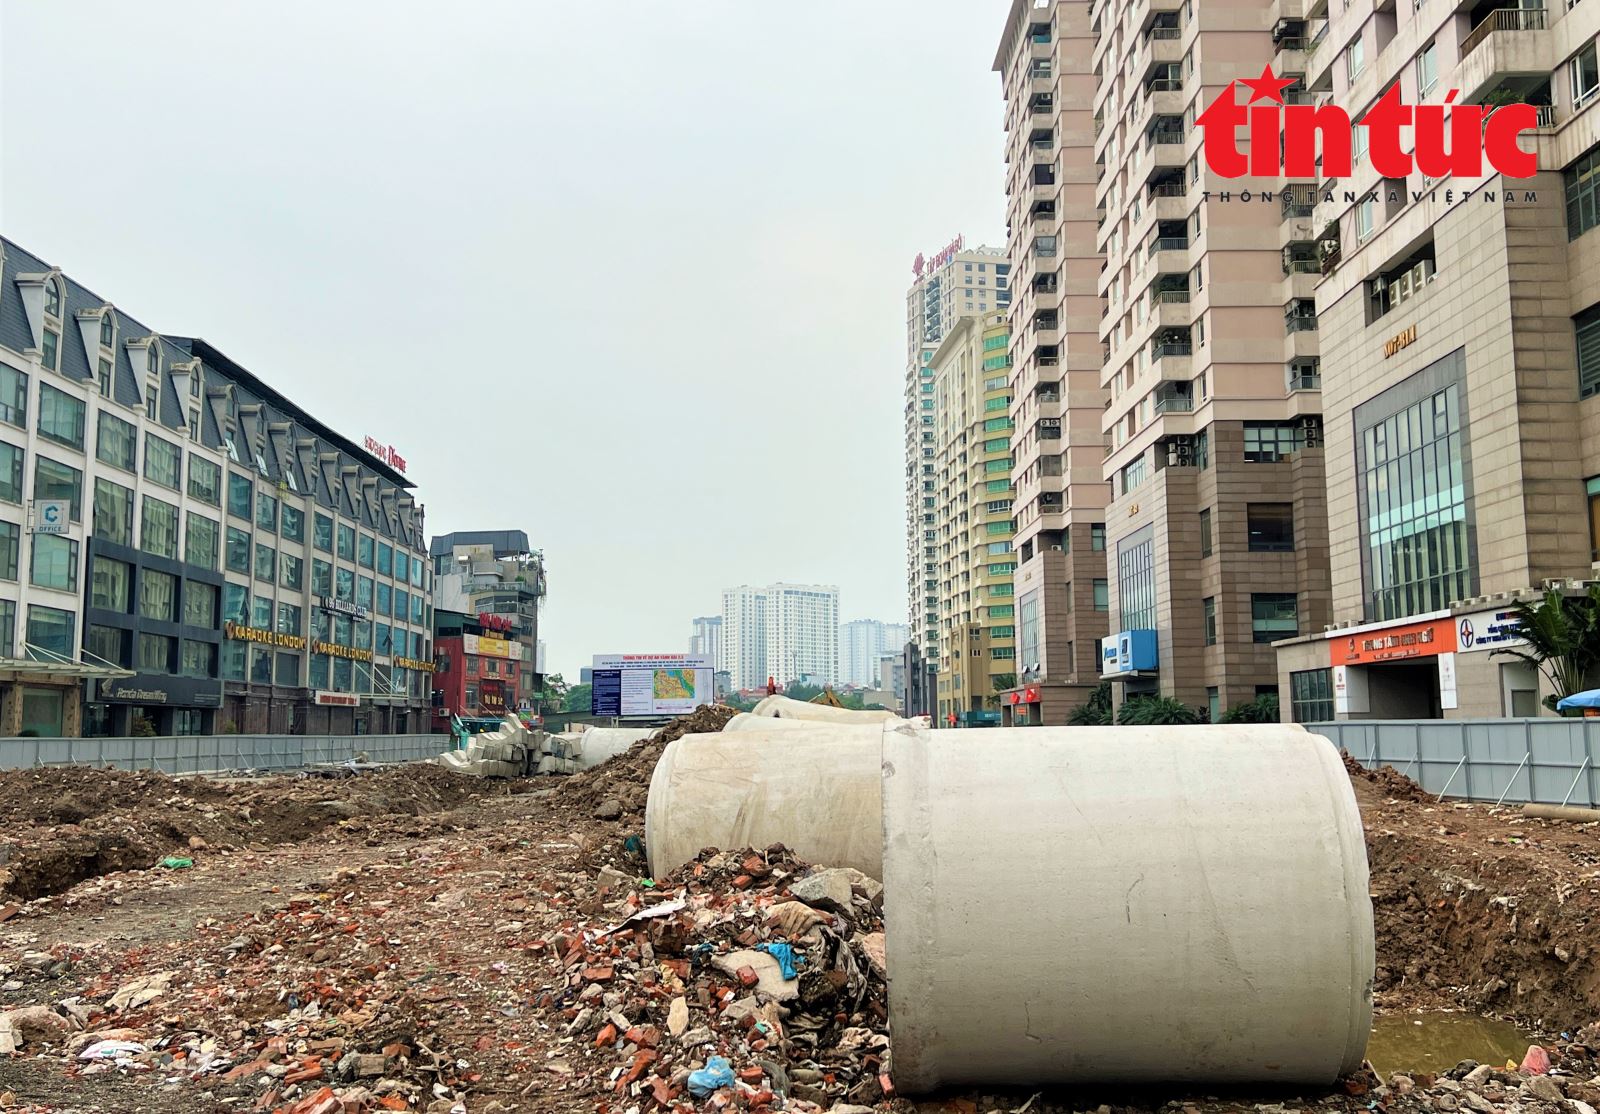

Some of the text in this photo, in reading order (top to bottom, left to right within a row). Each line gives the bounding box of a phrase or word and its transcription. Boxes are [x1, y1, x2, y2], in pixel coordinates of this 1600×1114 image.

[235, 625, 304, 649] KARAOKE LONDON
[319, 642, 371, 660] KARAOKE LONDON
